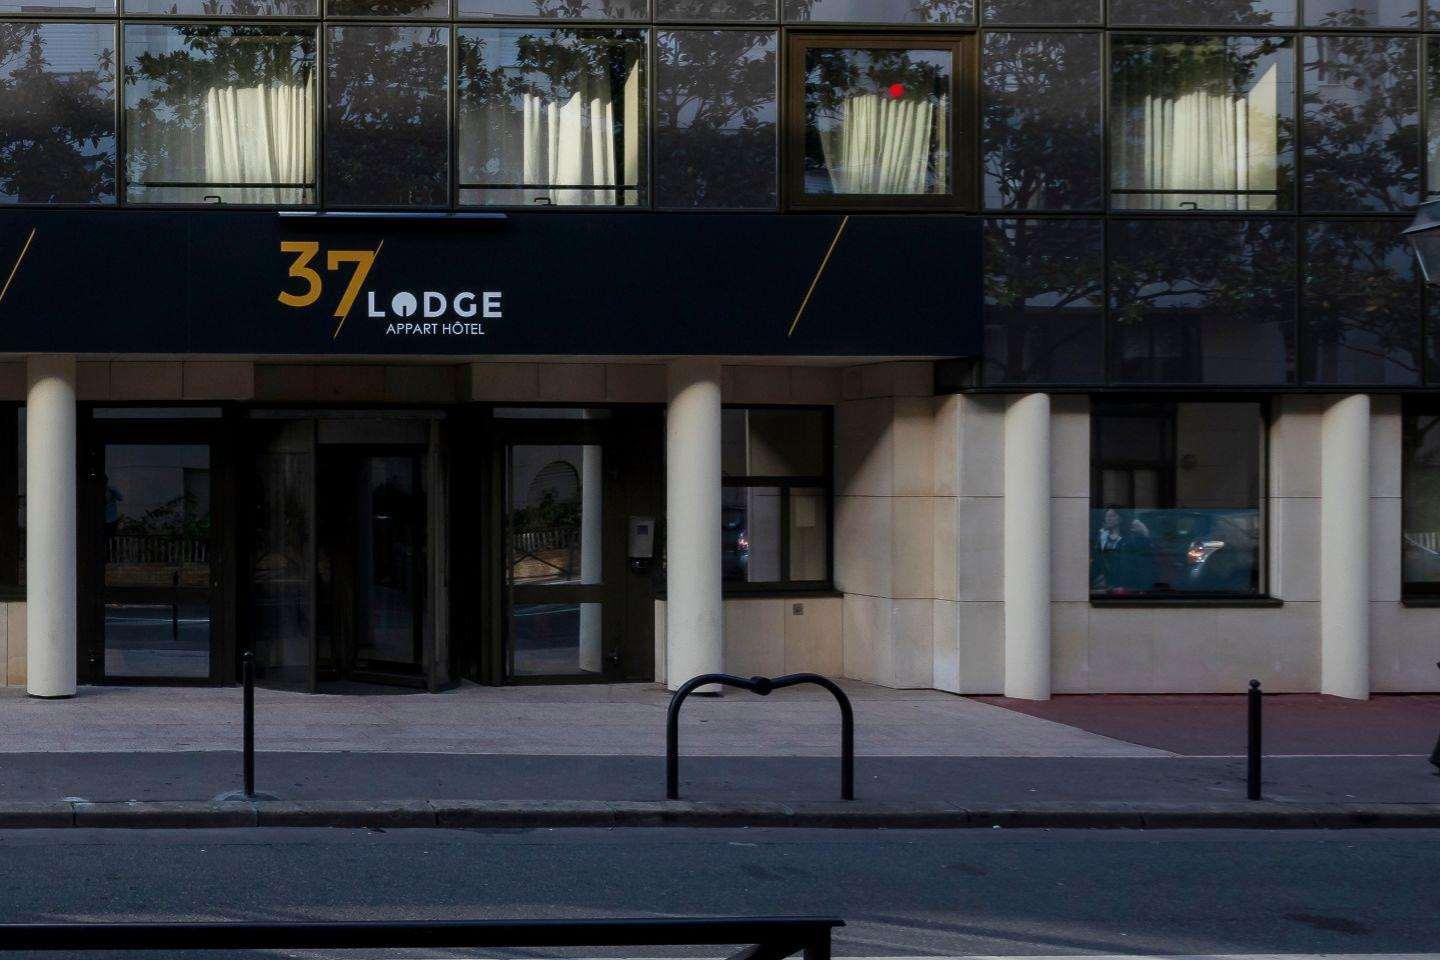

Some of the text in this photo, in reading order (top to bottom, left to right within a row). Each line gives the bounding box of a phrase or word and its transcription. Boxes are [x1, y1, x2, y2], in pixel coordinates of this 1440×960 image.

[277, 241, 503, 318] 37 LODGE
[385, 321, 485, 335] APPART HÔTEL
